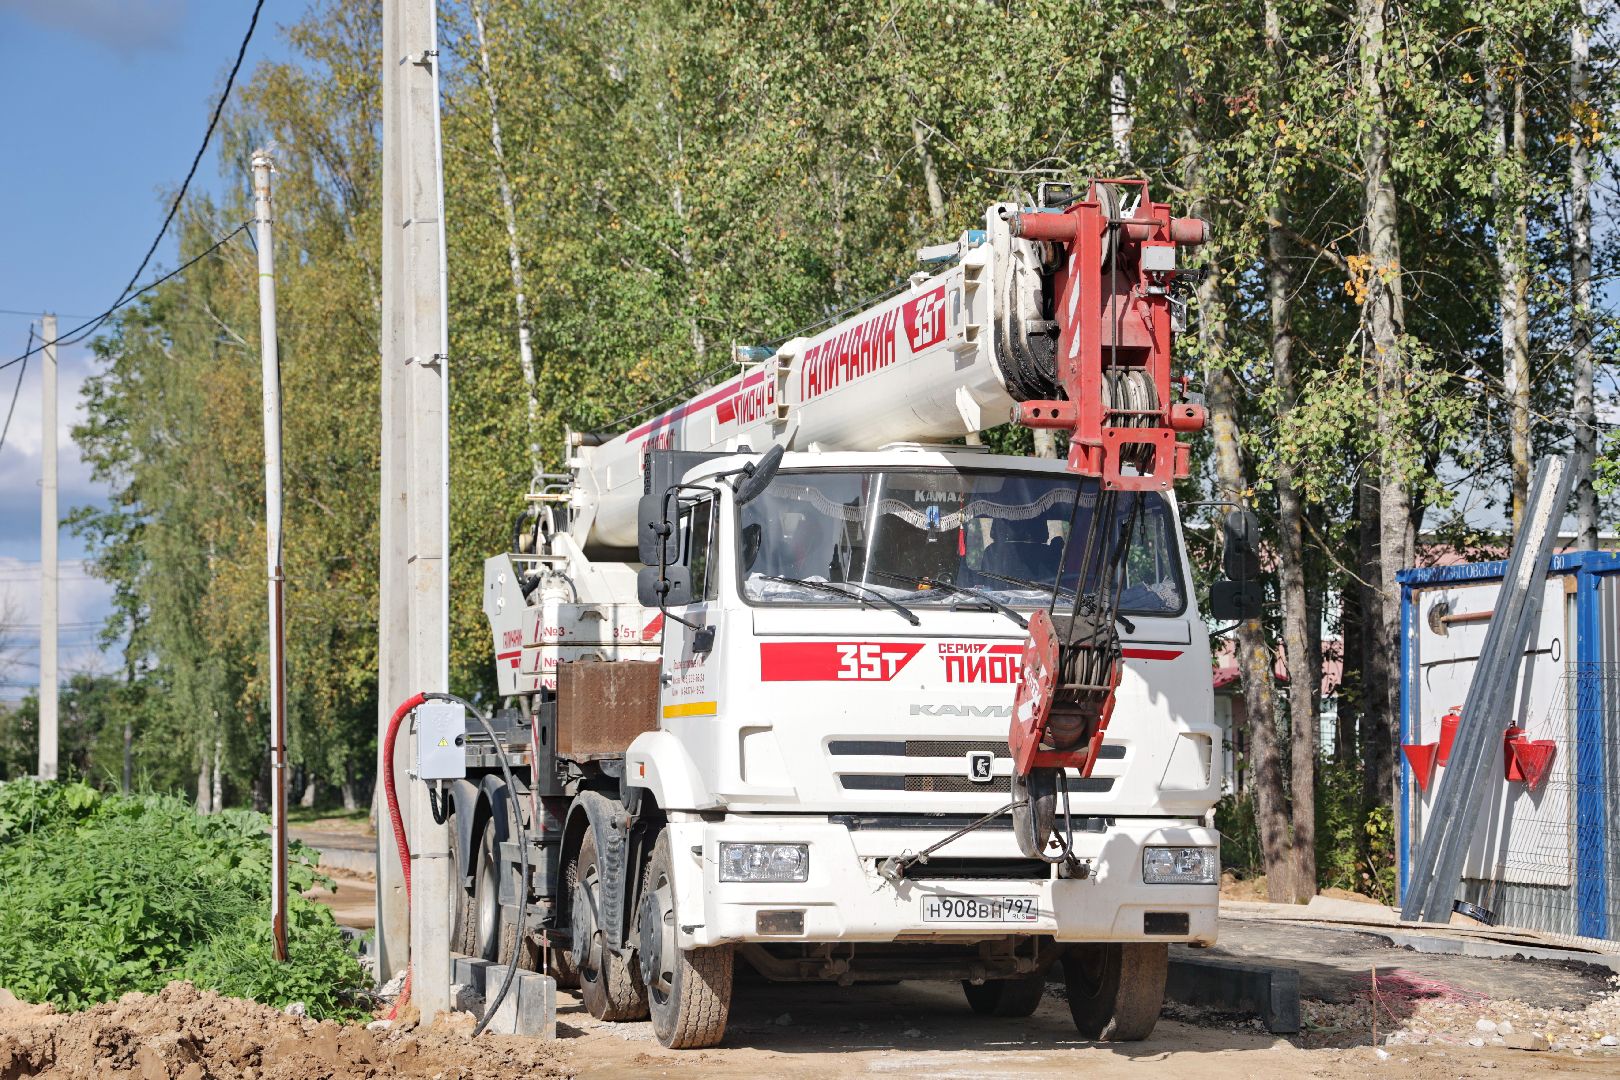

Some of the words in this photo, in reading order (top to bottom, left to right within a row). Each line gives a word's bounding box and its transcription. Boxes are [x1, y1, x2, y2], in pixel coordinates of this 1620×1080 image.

[801, 306, 900, 402] ГАЛИЧАНИН
[544, 626, 565, 637] №3
[938, 643, 984, 653] СЕРИЯ
[1005, 899, 1033, 914] 797
